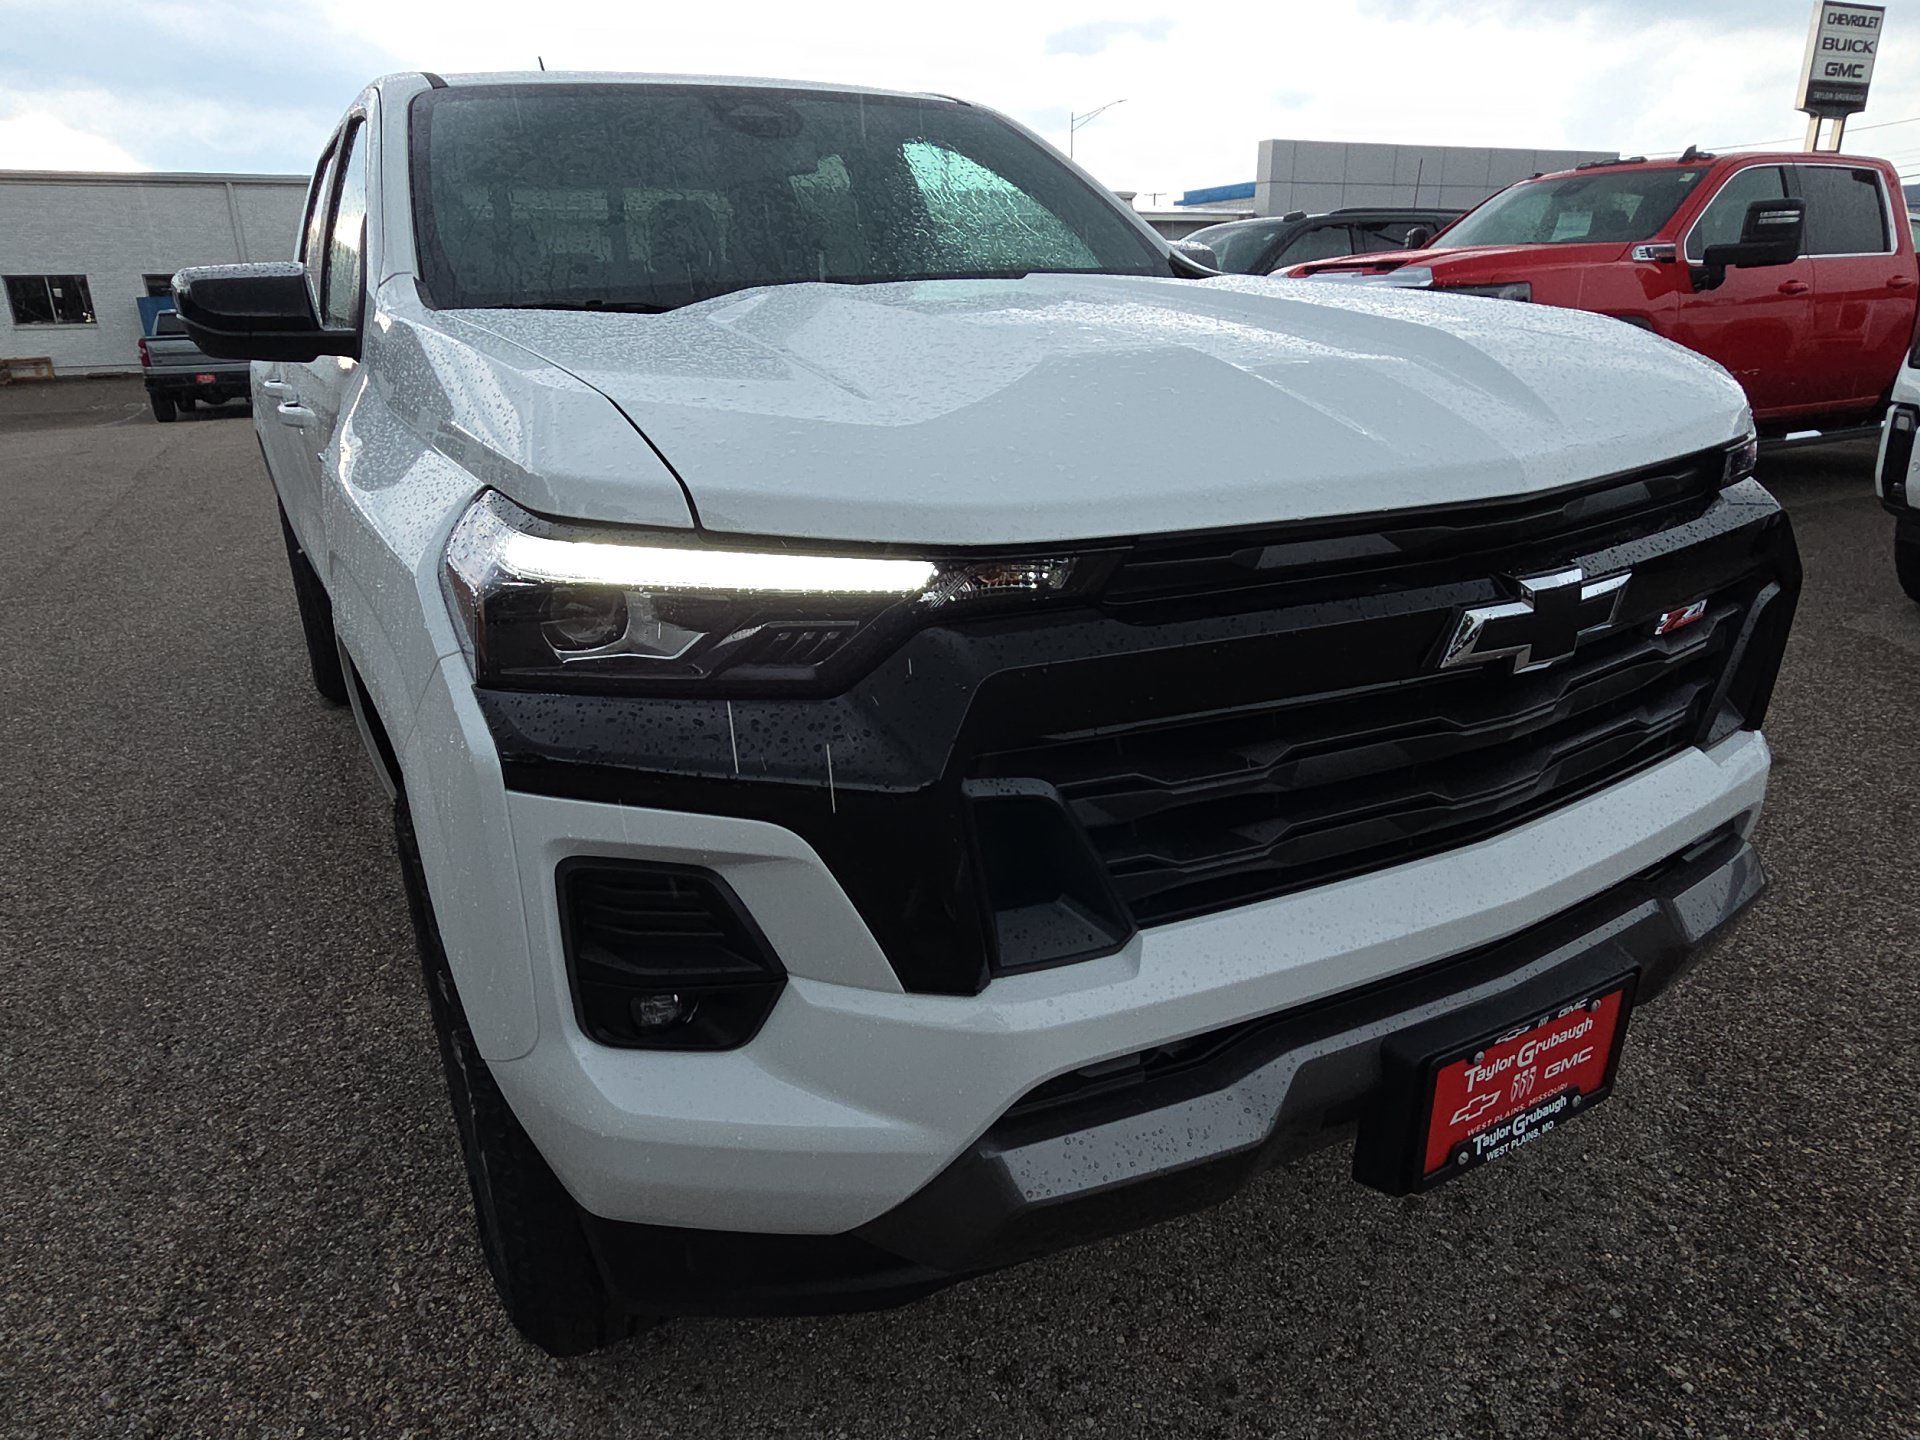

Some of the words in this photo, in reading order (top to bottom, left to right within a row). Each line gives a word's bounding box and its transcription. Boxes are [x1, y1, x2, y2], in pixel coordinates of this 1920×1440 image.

[1827, 12, 1880, 29] CHEVROLET
[1822, 37, 1874, 54] BUICK
[1824, 62, 1865, 78] GMC
[1557, 998, 1588, 1018] GMC
[1464, 1053, 1516, 1093] Taylor
[1516, 1017, 1594, 1068] Grubaugh
[1544, 1046, 1594, 1080] GMC
[1467, 1120, 1493, 1136] WEST
[1529, 1082, 1569, 1106] MISSOURI
[1473, 1125, 1512, 1156] Taylor
[1512, 1095, 1567, 1136] Grubaugh
[1485, 1143, 1510, 1162] WEST
[1542, 1120, 1555, 1133] MO
